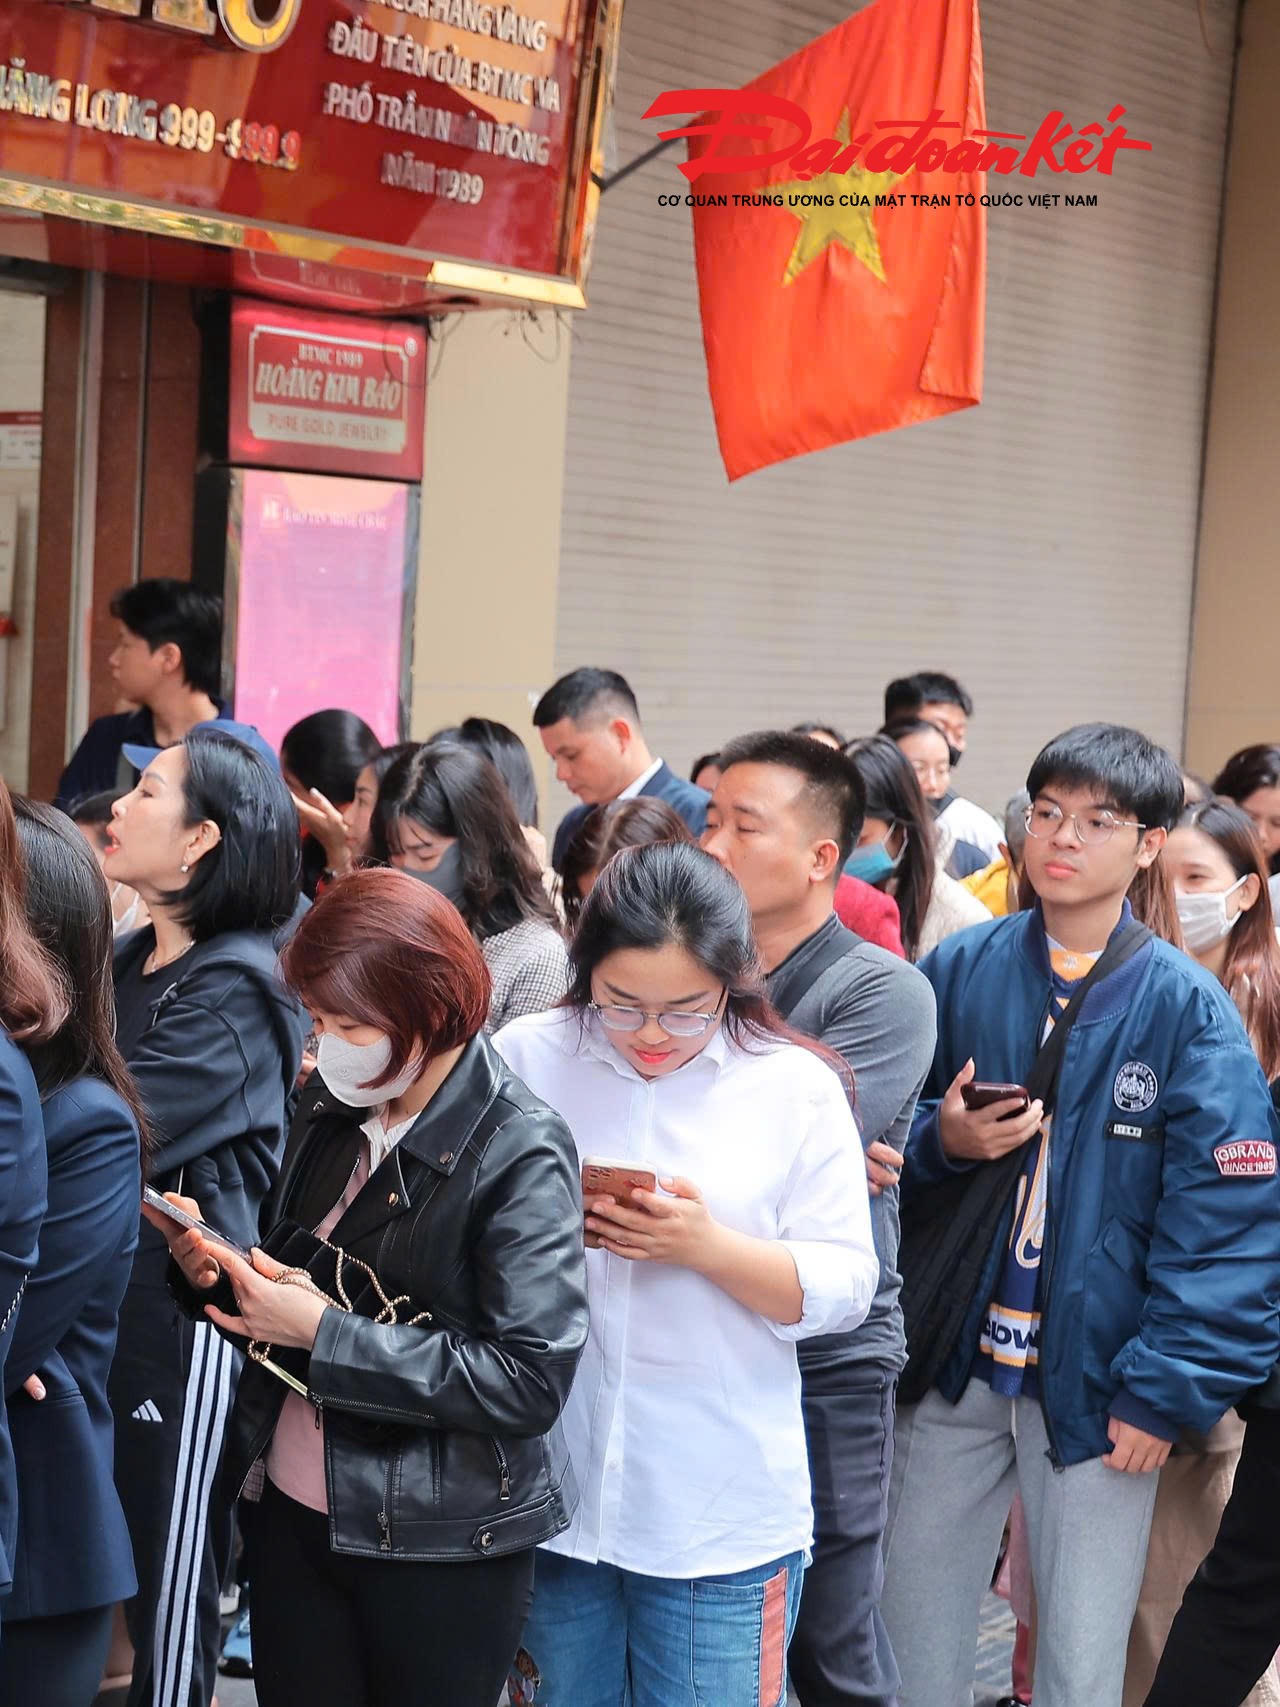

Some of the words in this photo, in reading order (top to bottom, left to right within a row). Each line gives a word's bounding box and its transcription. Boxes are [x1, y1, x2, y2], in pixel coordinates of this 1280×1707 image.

[329, 16, 378, 63] ĐẦU
[381, 34, 429, 77] TIÊN
[430, 43, 472, 89] CỦA
[476, 61, 531, 106] BTMC
[74, 83, 158, 141] LONG
[323, 81, 374, 123] PHỐ
[375, 90, 433, 138] TRẦN
[493, 121, 551, 166] TÔNG
[380, 150, 435, 194] NĂM
[436, 168, 484, 205] 1989
[323, 372, 361, 406] KIM
